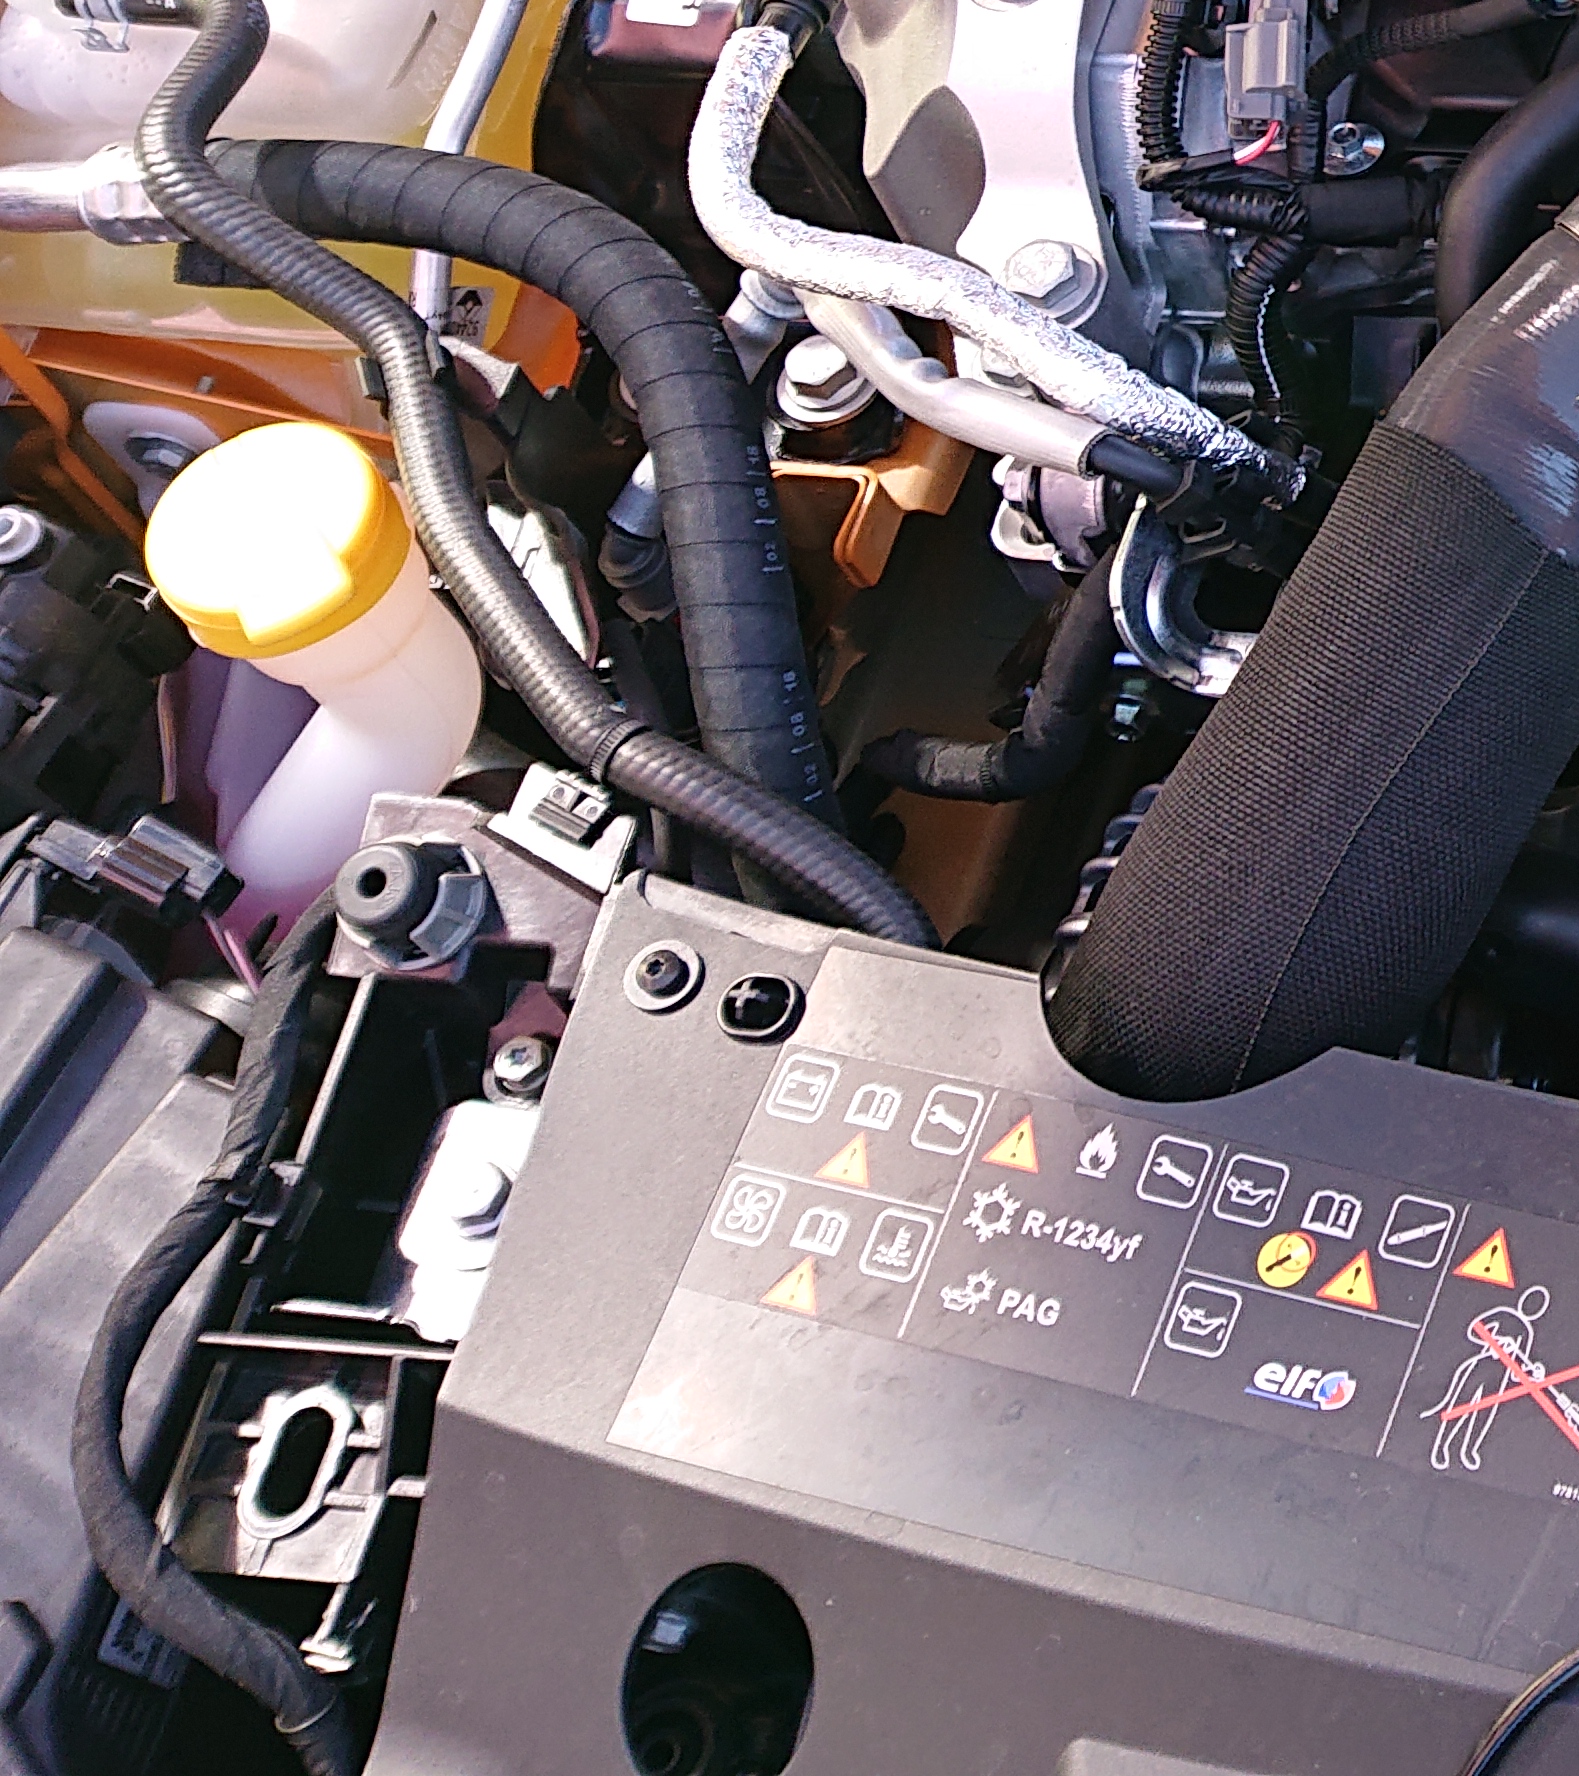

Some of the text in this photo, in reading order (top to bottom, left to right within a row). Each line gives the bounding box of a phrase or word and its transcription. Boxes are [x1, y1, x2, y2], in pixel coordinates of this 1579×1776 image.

[1020, 1209, 1141, 1263] R-1234yf
[996, 1288, 1062, 1327] PAG
[1251, 1359, 1322, 1400] elf
